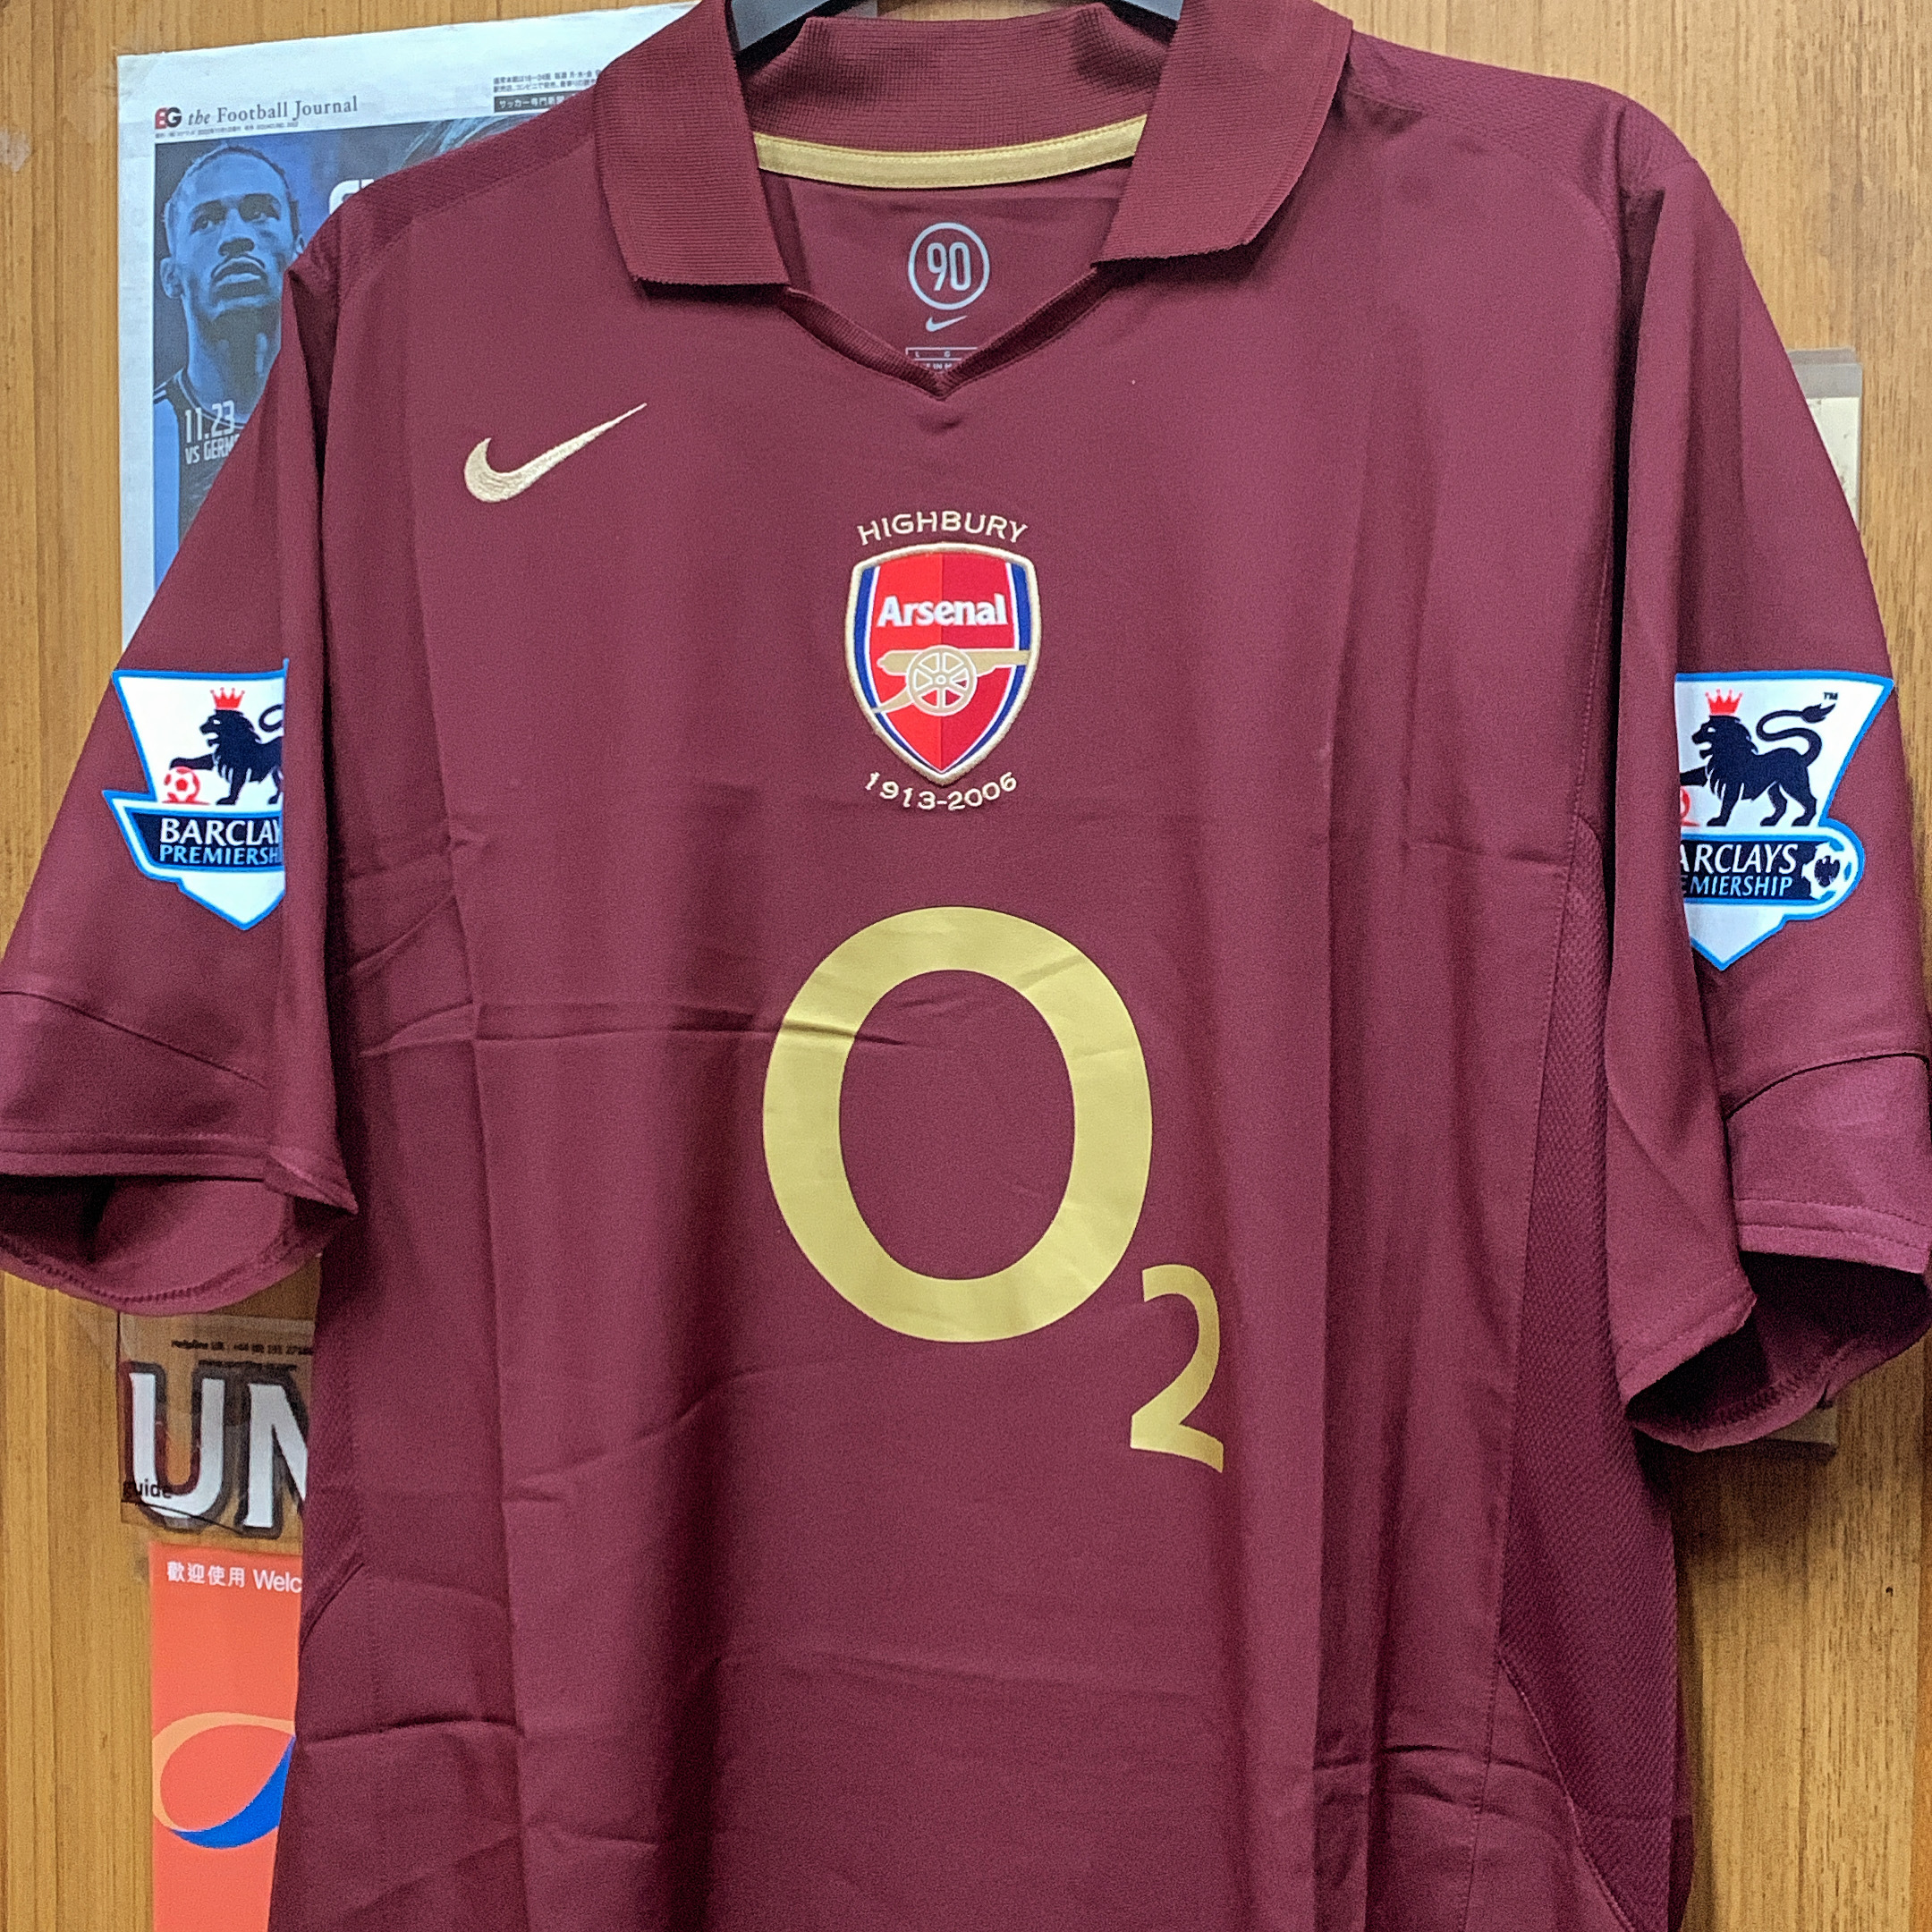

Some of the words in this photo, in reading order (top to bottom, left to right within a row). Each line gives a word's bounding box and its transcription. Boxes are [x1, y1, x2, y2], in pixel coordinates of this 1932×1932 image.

[188, 110, 210, 126] the
[216, 101, 288, 123] Football
[292, 95, 358, 121] Journal
[927, 242, 972, 292] 90
[184, 399, 235, 444] 11.23
[185, 445, 200, 464] VS
[856, 510, 1028, 546] HIGHBURY
[877, 593, 1009, 627] Arsenal
[864, 771, 1018, 812] 1913-2006
[166, 1560, 246, 1589] 歡迎使用
[252, 1569, 302, 1593] Welc
